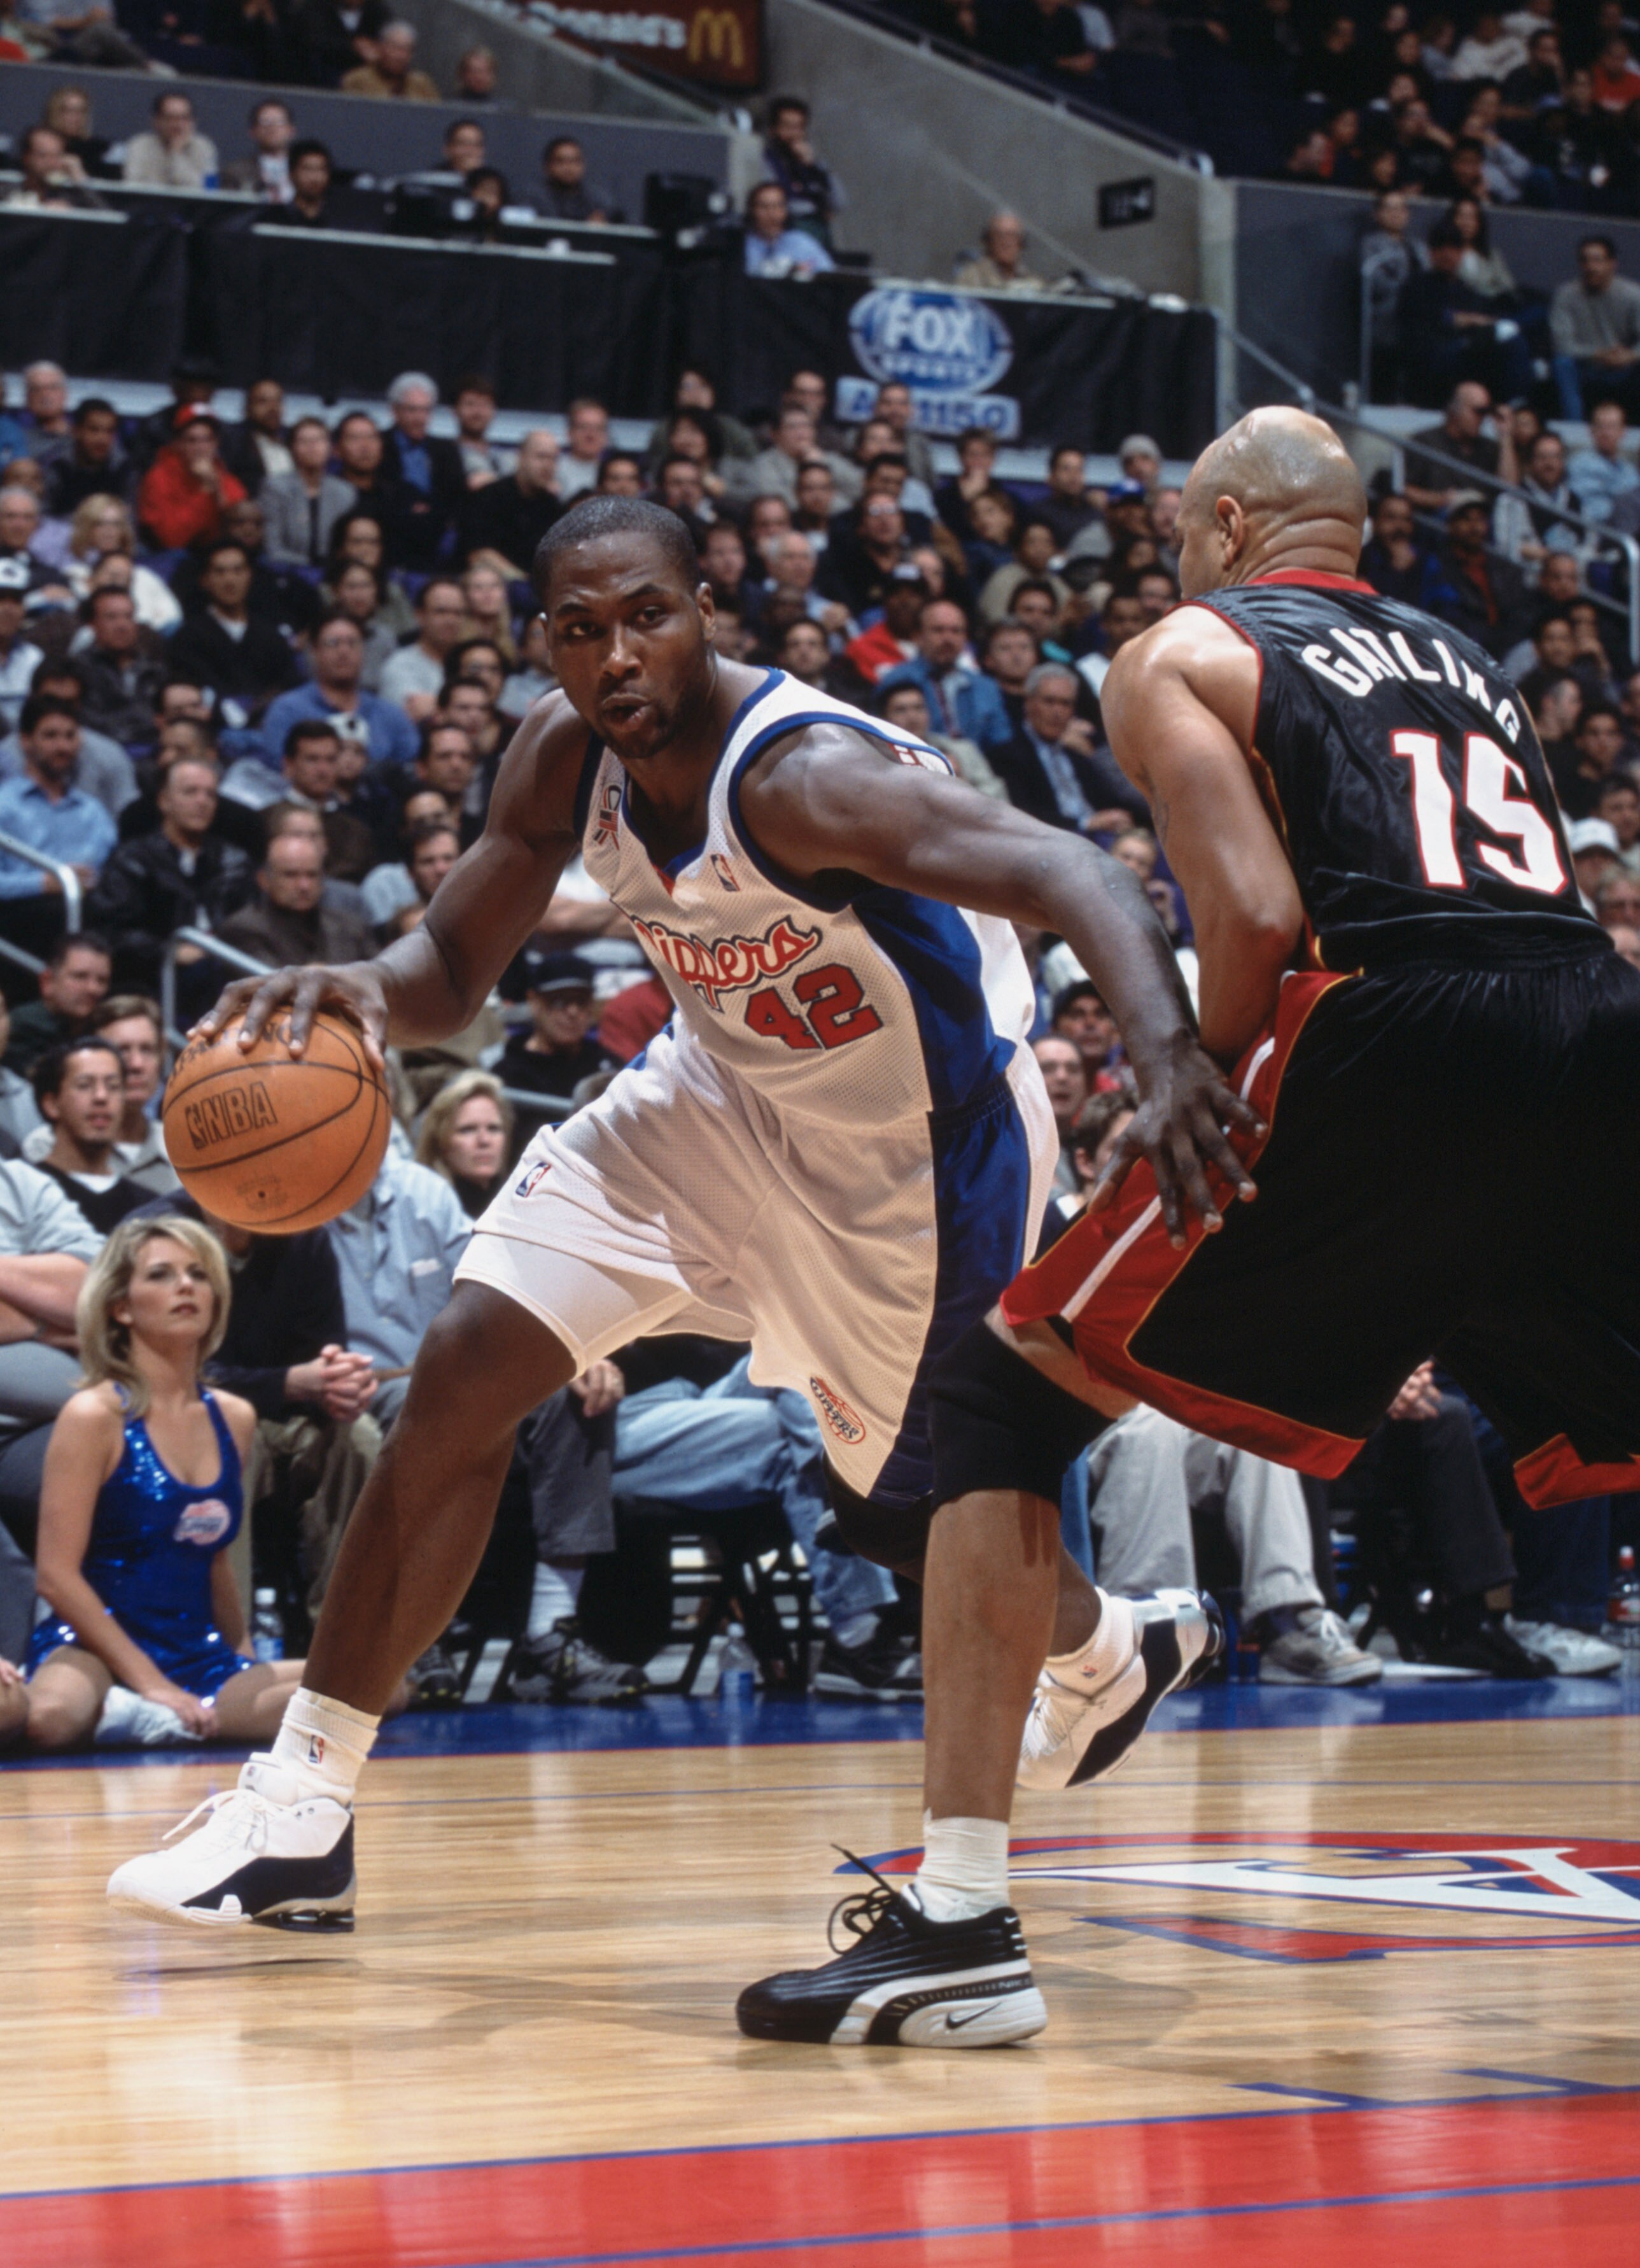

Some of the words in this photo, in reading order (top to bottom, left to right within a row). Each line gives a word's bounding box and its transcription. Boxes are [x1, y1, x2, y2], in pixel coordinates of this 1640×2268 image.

[883, 294, 976, 355] FOX
[1301, 627, 1522, 744] GATLING
[1389, 728, 1569, 896] 15
[744, 962, 884, 1050] 42
[200, 1081, 278, 1145] NBA
